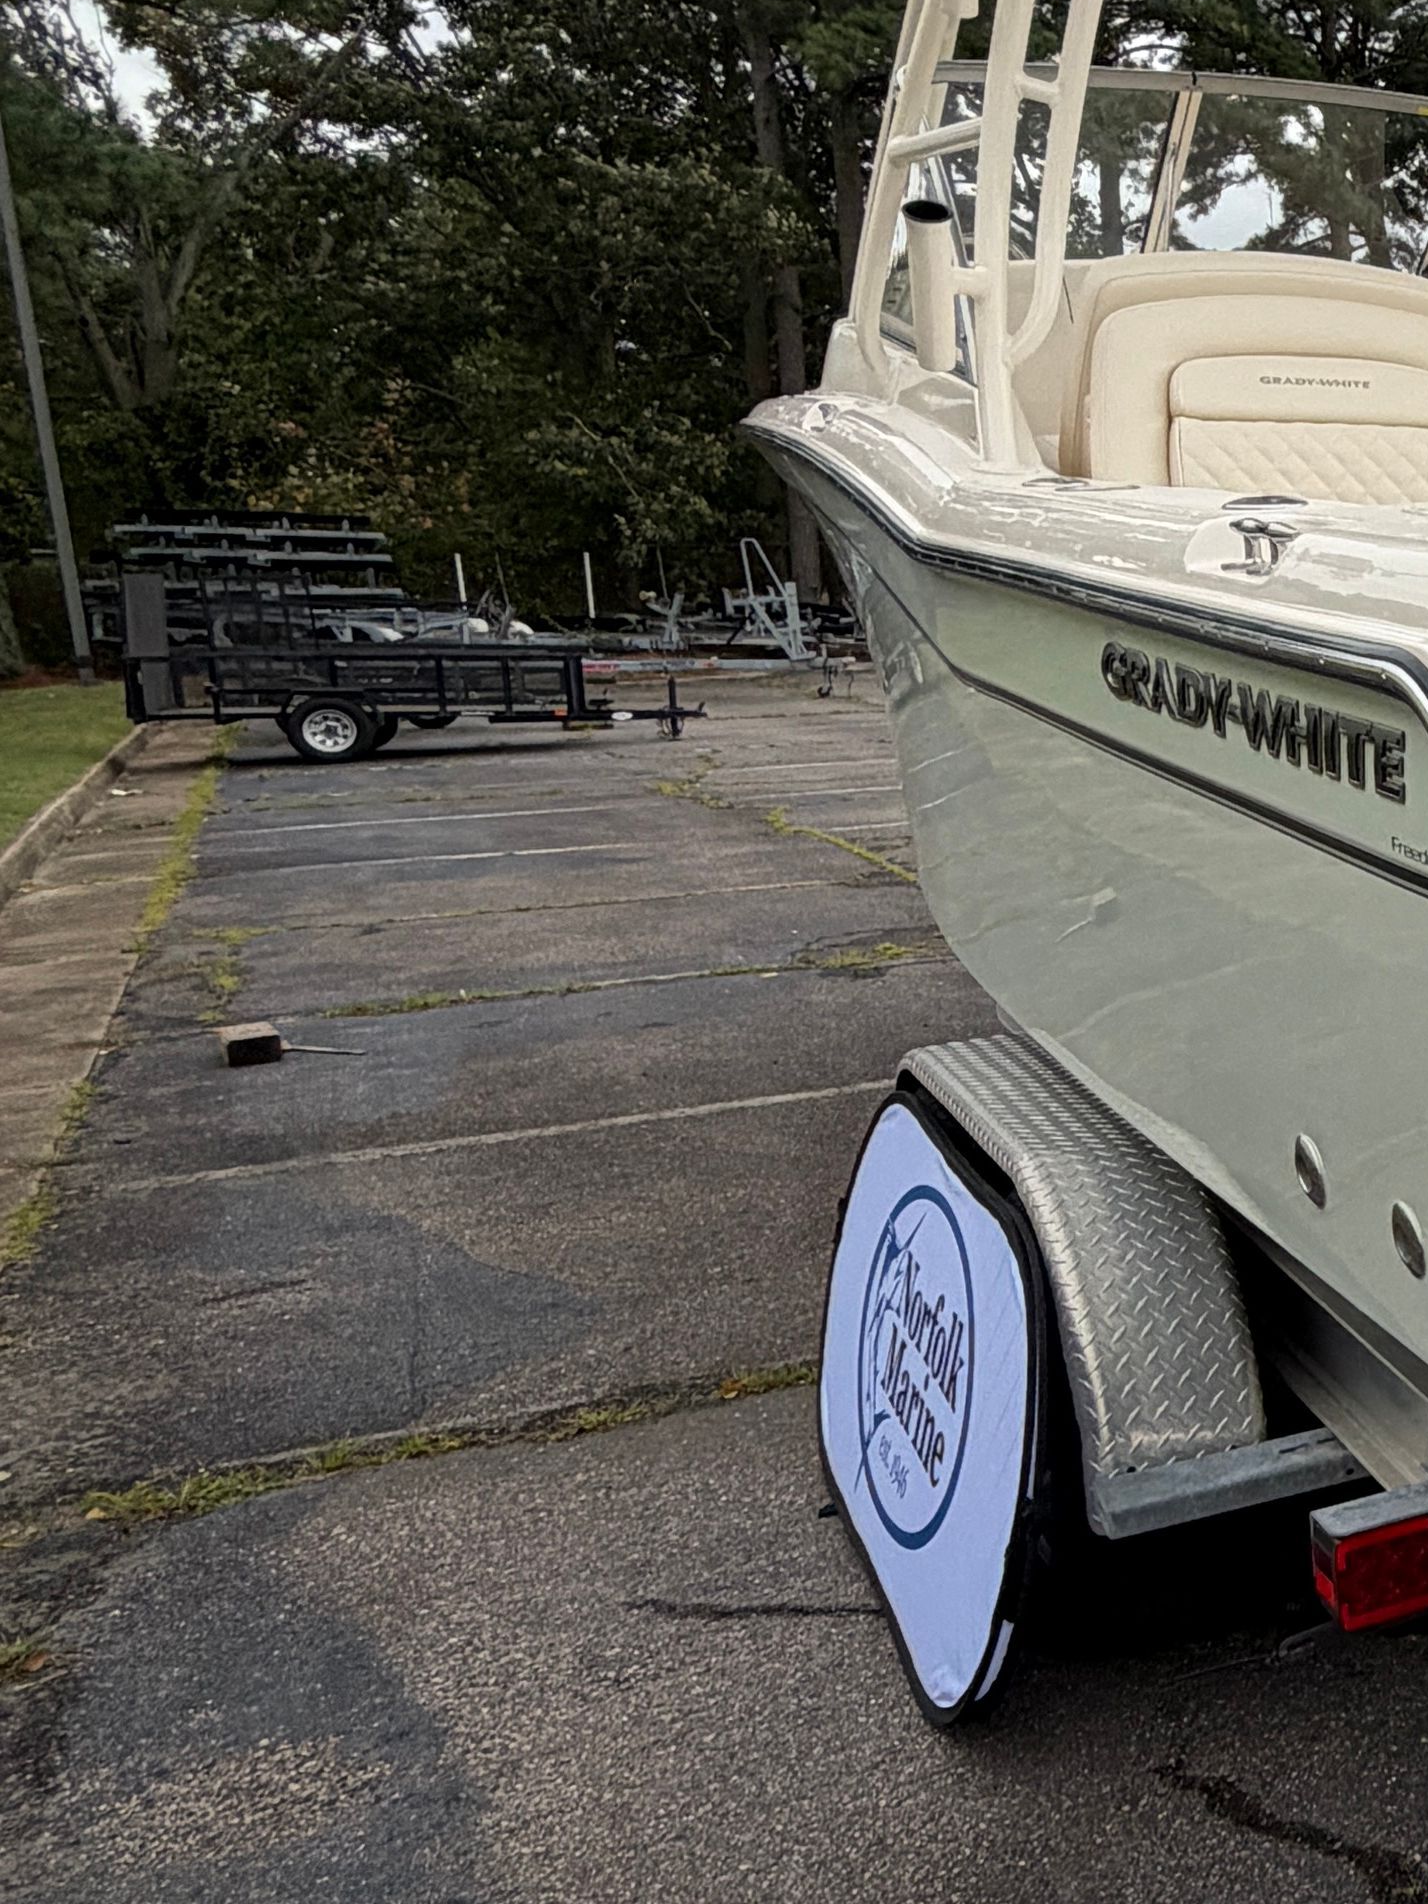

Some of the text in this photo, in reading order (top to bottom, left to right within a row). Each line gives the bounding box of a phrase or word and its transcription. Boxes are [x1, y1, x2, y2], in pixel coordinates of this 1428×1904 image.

[1259, 375, 1370, 389] GRADY-WHITE
[1101, 641, 1406, 805] GRADY-WHITE
[881, 1322, 945, 1488] Marine
[897, 1250, 964, 1414] Norfolk
